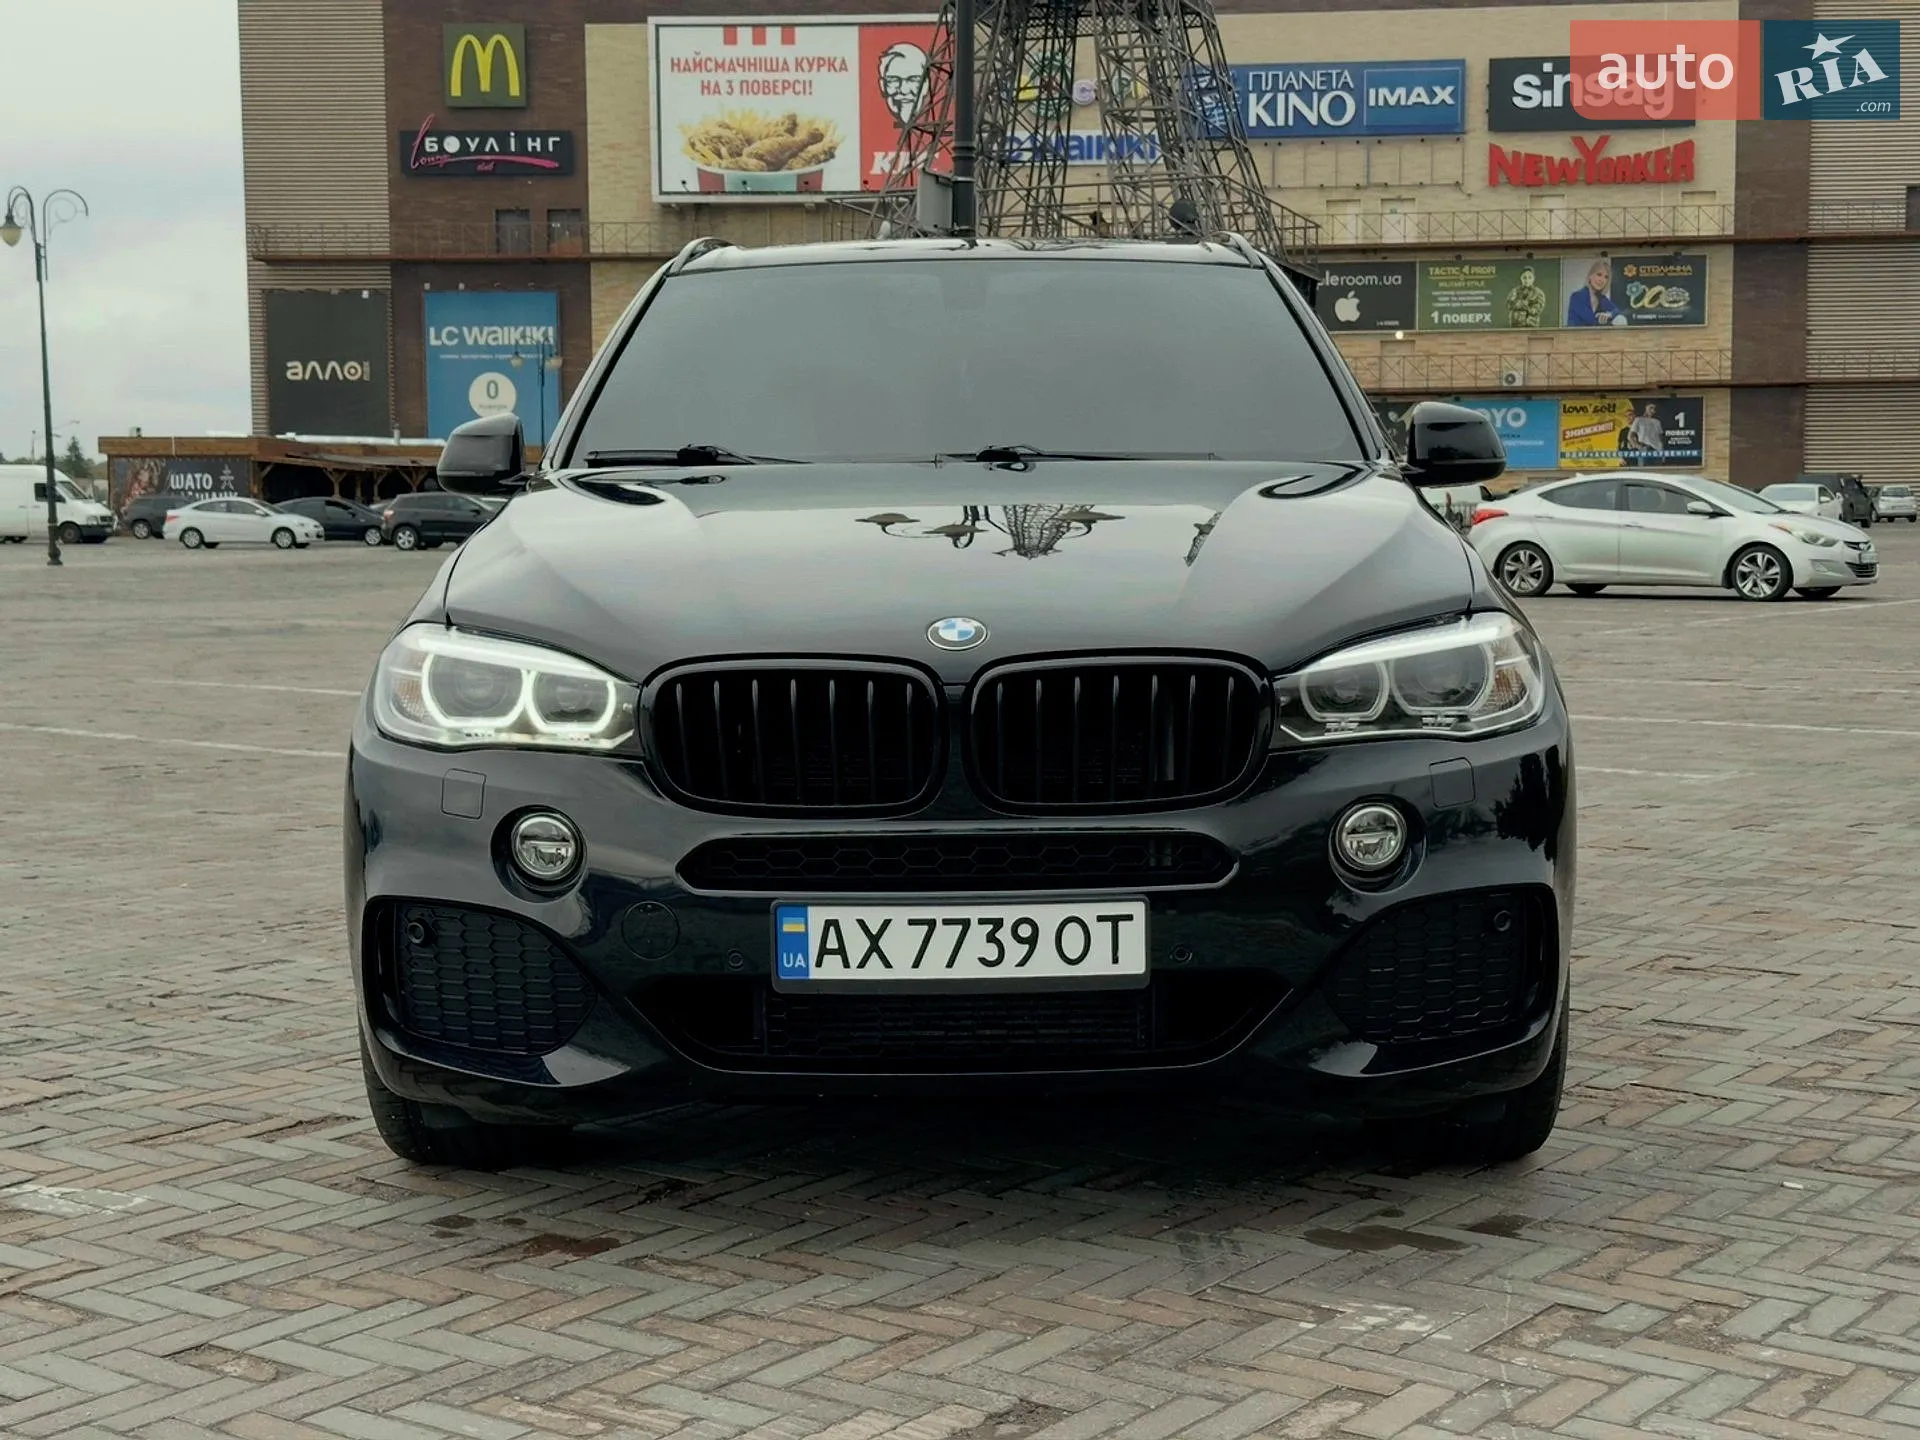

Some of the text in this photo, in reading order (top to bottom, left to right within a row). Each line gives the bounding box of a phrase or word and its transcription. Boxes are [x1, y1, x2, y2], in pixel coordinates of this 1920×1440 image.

[670, 51, 849, 73] НАЙСМАЧНІША КУРКА
[700, 79, 813, 96] НА 3 ПОВЕРСІ!
[1368, 85, 1456, 107] IMAX
[1248, 90, 1356, 127] KINO
[424, 132, 561, 153] БОУЛІНГ
[1430, 310, 1493, 324] 1 ПОВЕРХ
[428, 326, 458, 346] LC
[1674, 411, 1685, 428] 1
[814, 913, 1135, 969] AX 7739 OT
[781, 953, 807, 968] UA
